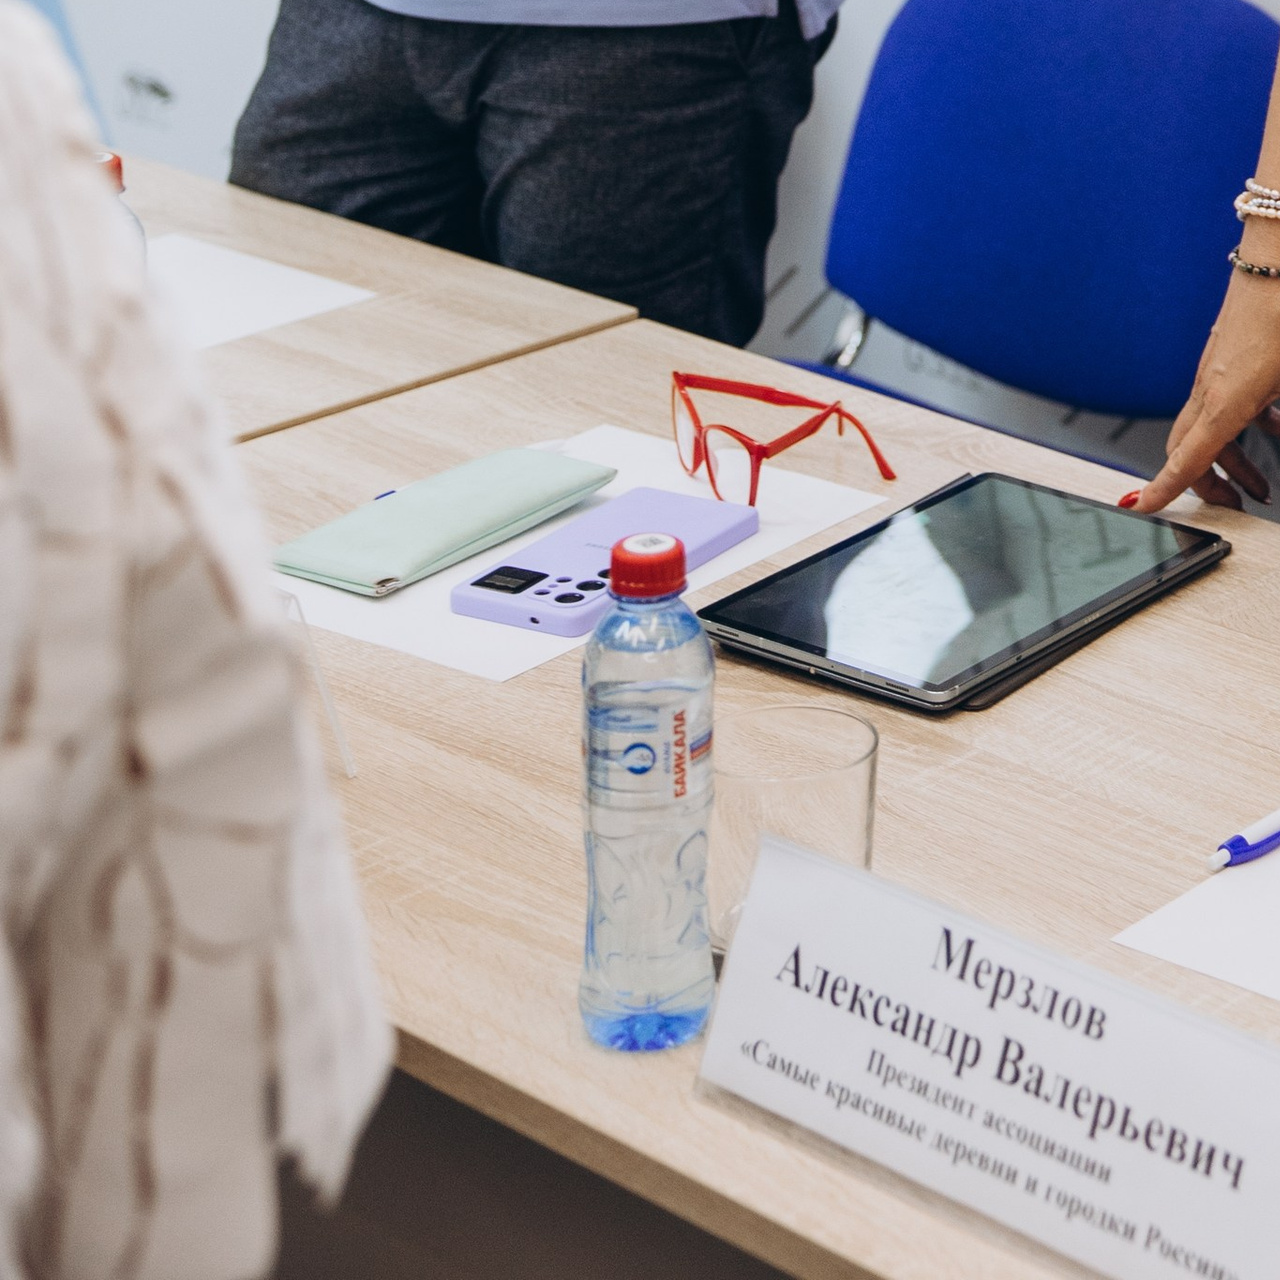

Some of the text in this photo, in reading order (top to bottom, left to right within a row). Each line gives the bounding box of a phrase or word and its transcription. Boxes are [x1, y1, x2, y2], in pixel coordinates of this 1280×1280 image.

[674, 709, 687, 798] БАЙКАЛА
[932, 926, 1107, 1040] Мерзлов
[776, 943, 1247, 1190] Александр Валерьевич
[866, 1049, 1112, 1184] Президент ассоциации
[824, 1080, 927, 1141] красивые
[928, 1133, 1019, 1185] деревни
[1025, 1175, 1039, 1194] и
[1045, 1186, 1137, 1242] городки
